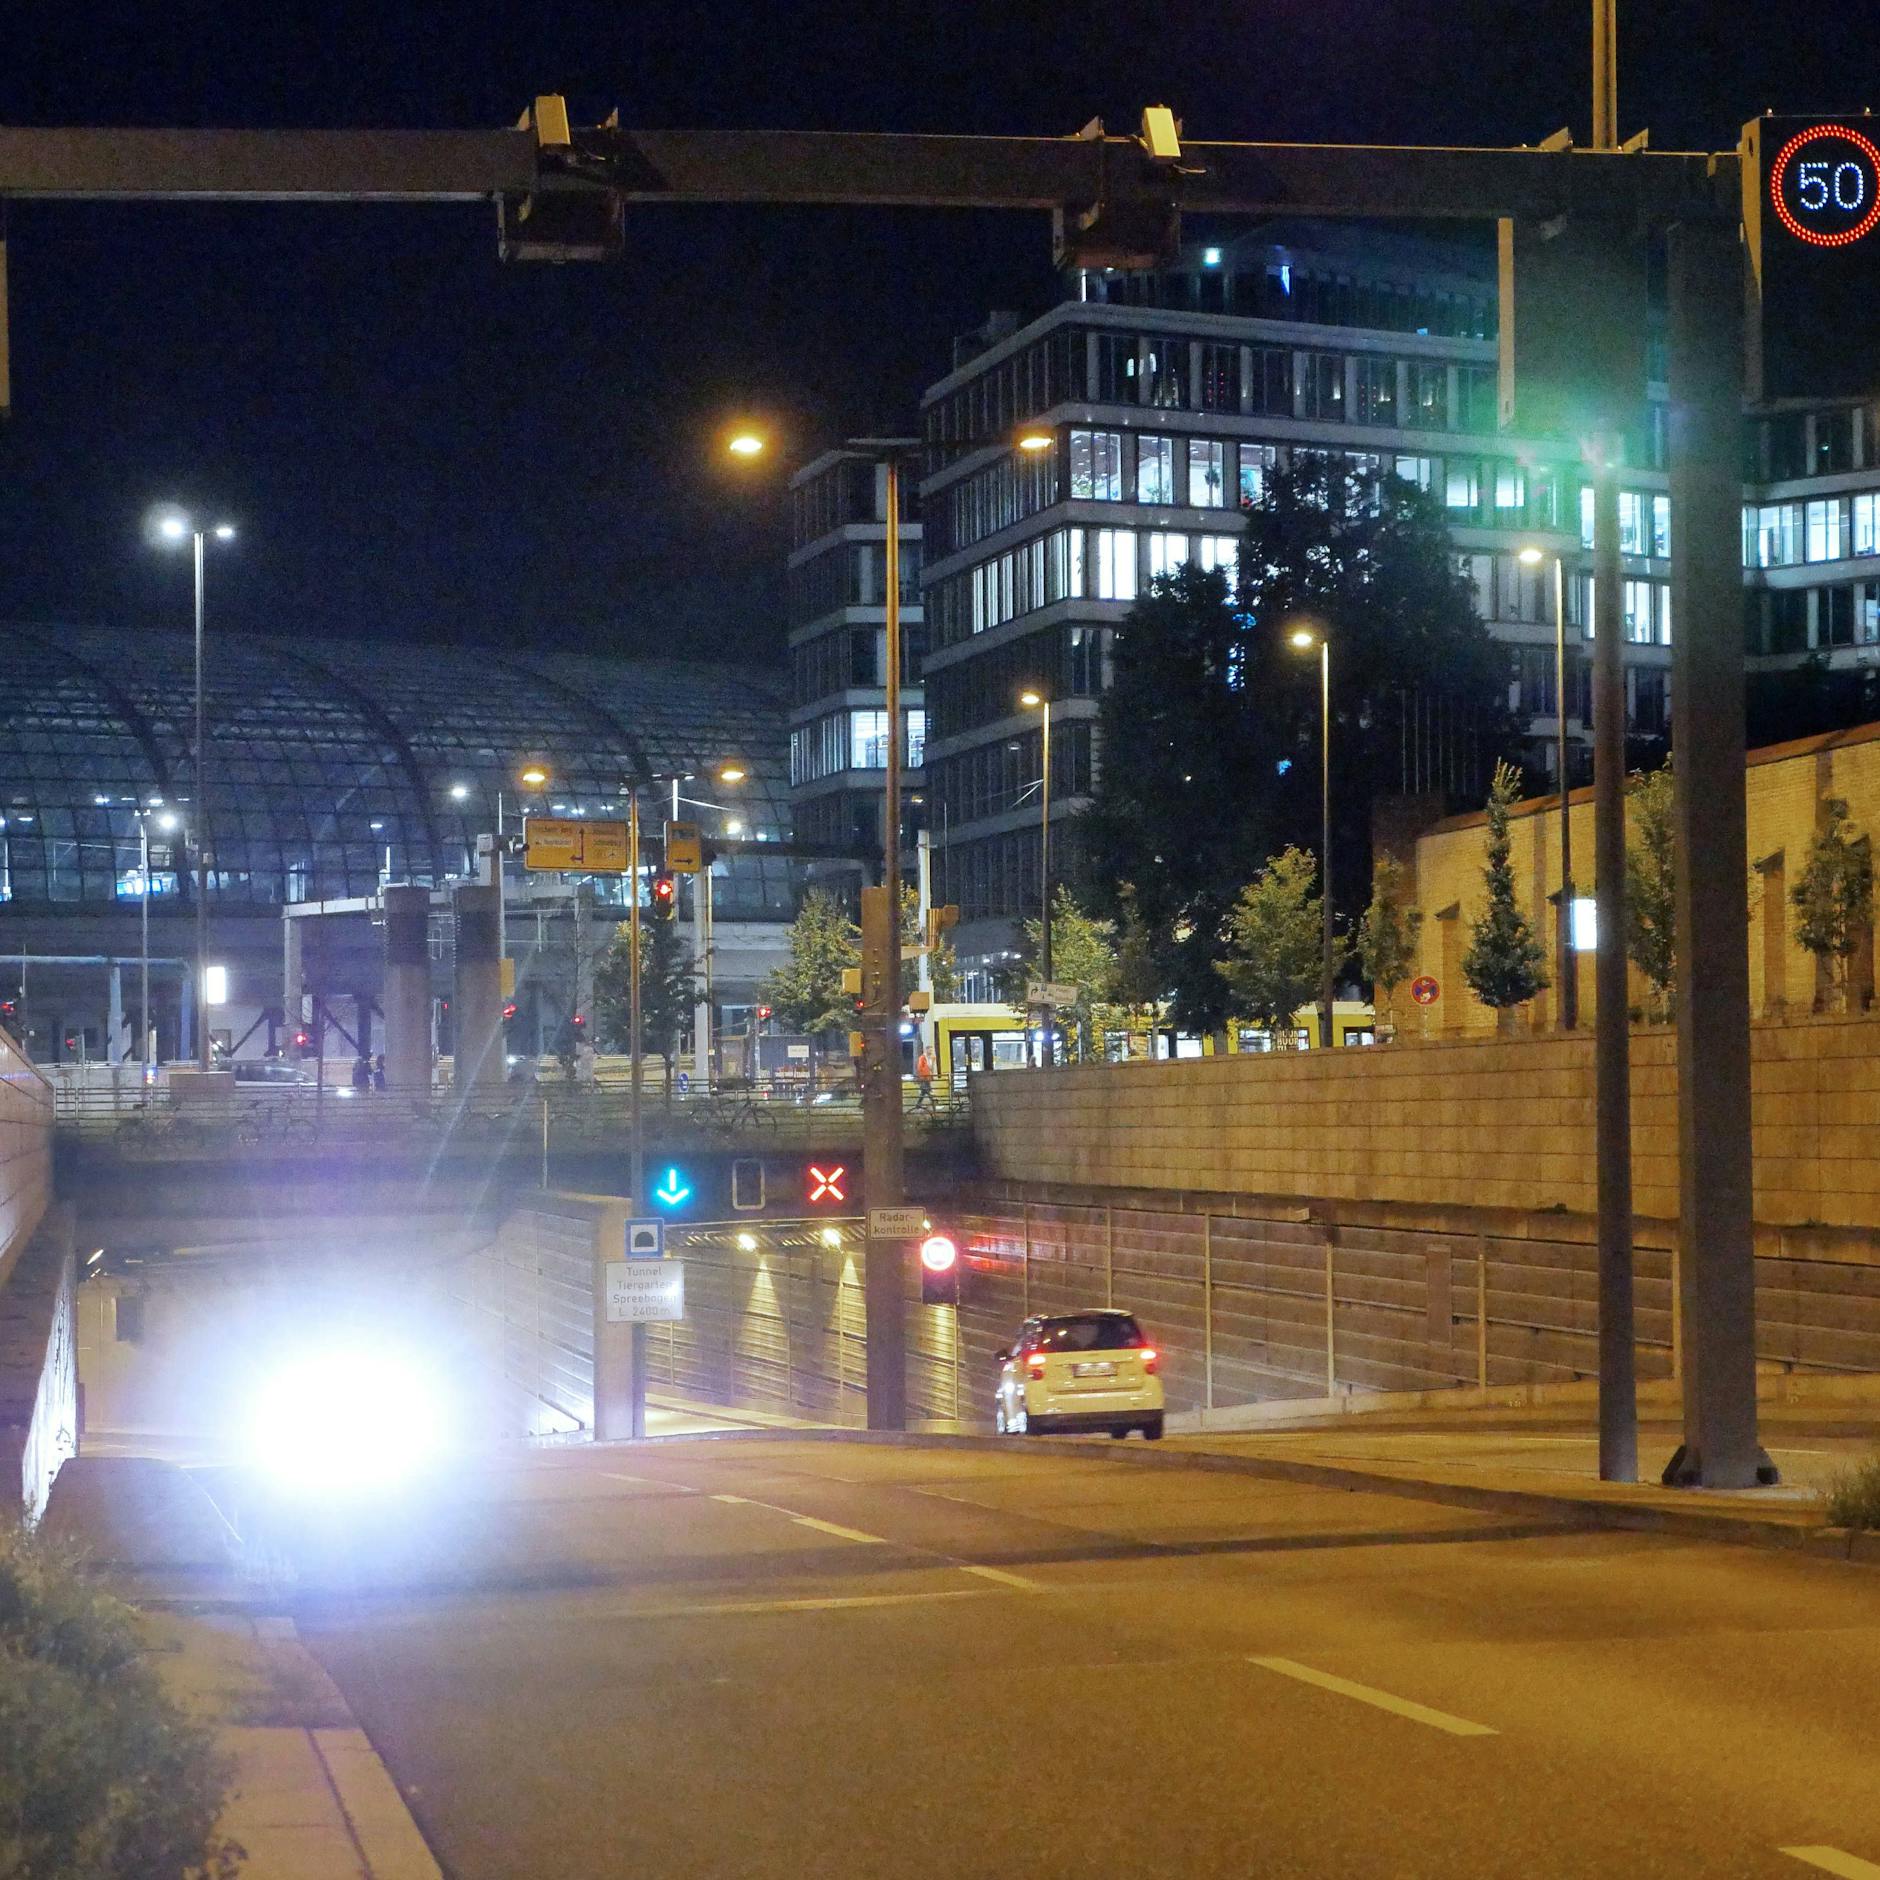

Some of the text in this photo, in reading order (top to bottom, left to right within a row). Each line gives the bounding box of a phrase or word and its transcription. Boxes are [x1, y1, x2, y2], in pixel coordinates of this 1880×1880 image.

[1799, 161, 1864, 210] 50
[879, 1212, 916, 1222] Radar-
[874, 1224, 919, 1234] kontrolle
[626, 1265, 662, 1277] Tunnel
[617, 1280, 673, 1291] Tiergarten
[632, 1306, 658, 1317] 2400
